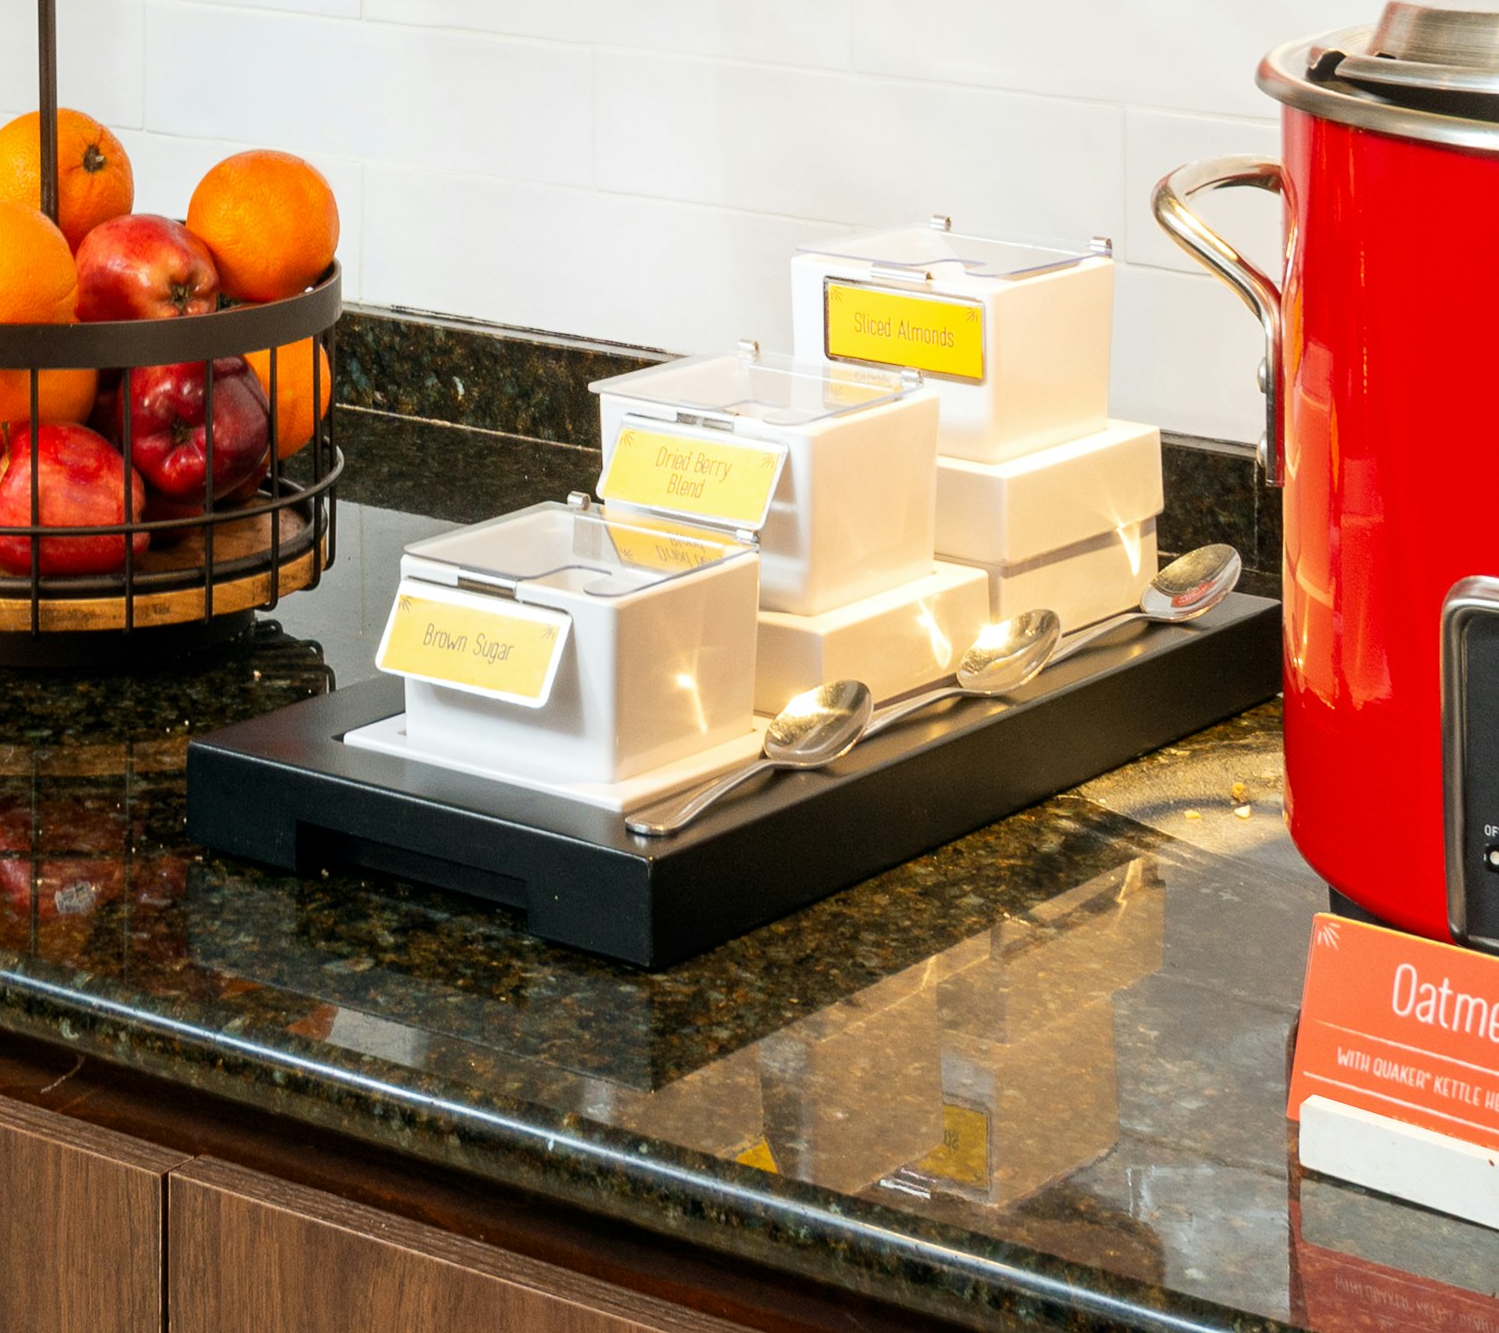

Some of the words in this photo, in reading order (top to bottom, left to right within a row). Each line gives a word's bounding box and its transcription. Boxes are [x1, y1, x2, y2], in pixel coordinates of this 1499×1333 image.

[854, 312, 891, 337] Sliced
[897, 320, 955, 348] Almonds
[655, 446, 693, 471] Dried
[694, 453, 732, 483] Berry
[667, 473, 706, 499] Blend
[423, 622, 468, 652] Brown
[473, 633, 515, 665] Sugar
[1336, 1046, 1370, 1073] WITH
[1433, 1075, 1482, 1107] KETTLE
